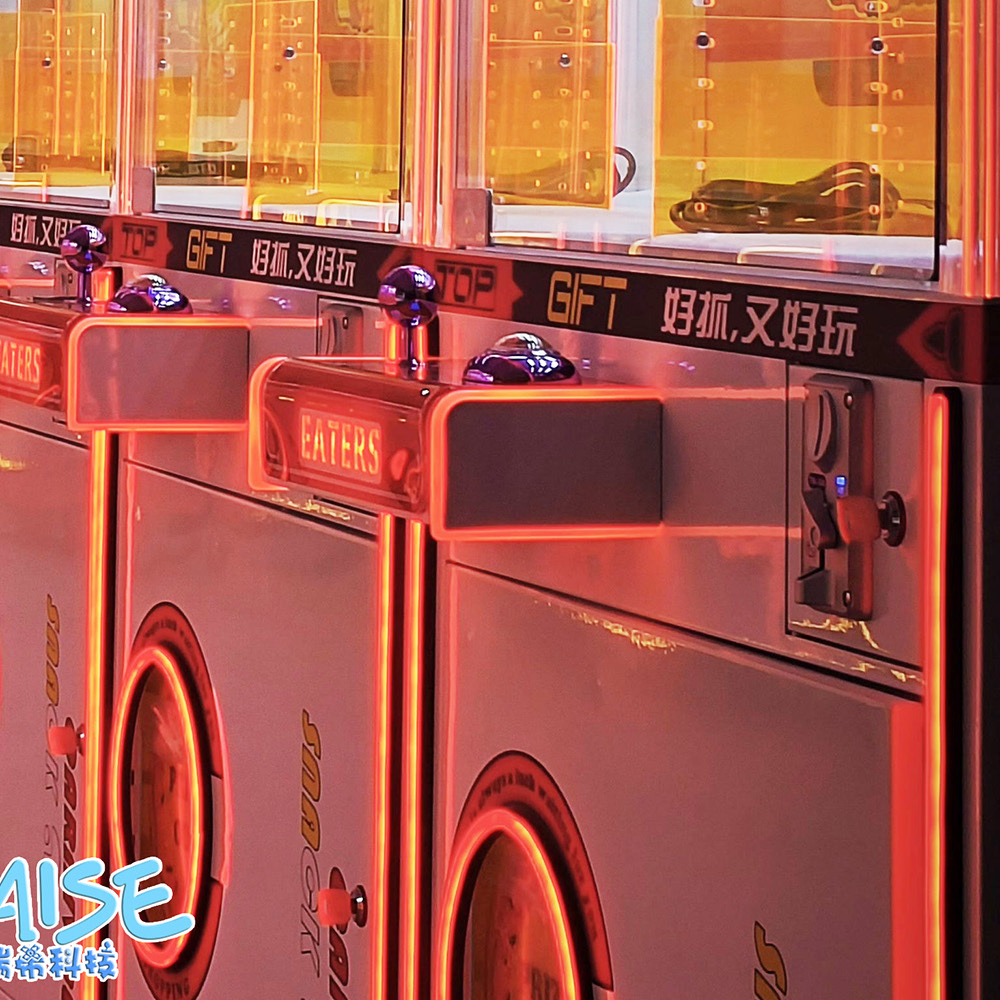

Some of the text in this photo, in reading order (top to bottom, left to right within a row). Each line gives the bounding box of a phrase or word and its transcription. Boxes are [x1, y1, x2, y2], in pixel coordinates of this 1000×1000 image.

[186, 228, 233, 274] GIFT
[435, 263, 498, 307] TOP
[547, 270, 628, 331] GIFT
[301, 414, 380, 475] EATERS
